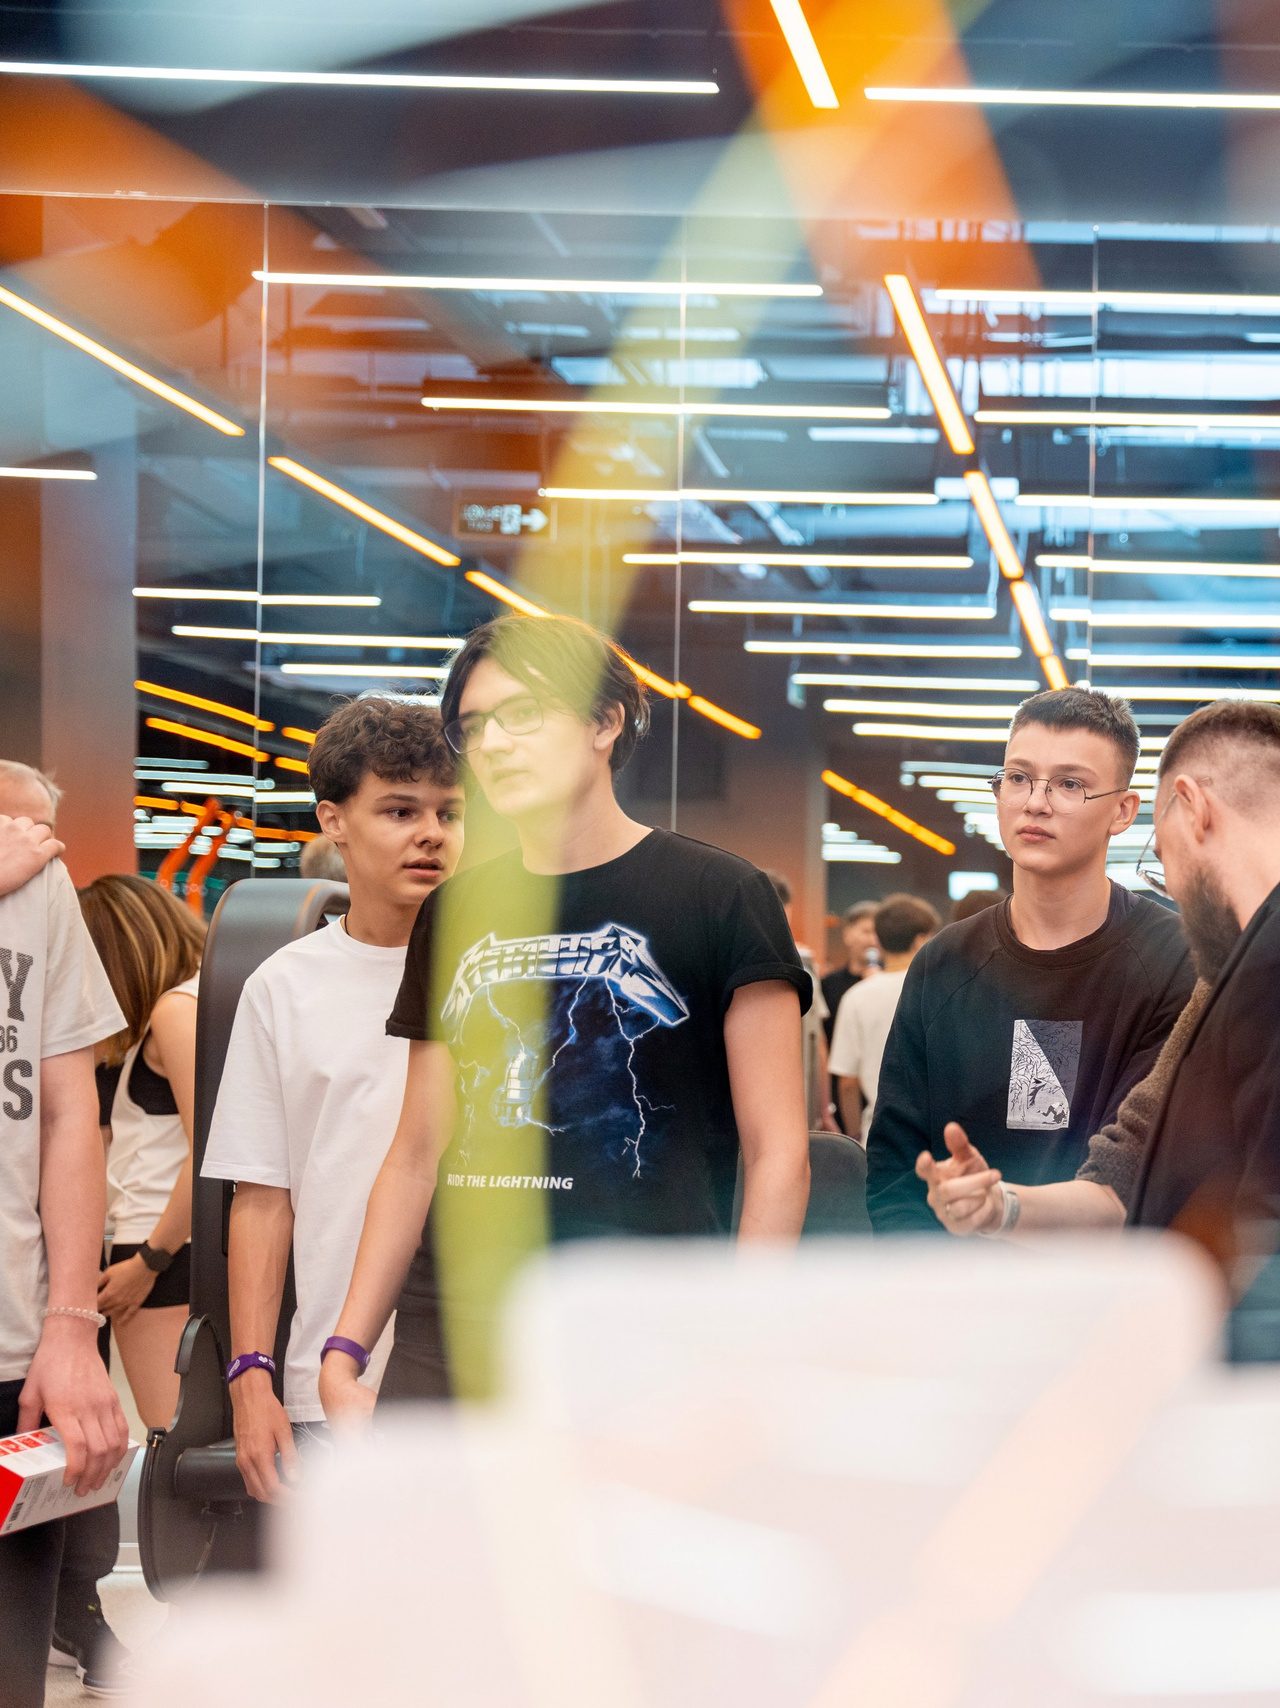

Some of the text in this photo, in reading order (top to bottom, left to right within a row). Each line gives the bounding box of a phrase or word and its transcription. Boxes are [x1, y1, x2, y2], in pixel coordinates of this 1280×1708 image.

[447, 1173, 574, 1190] RIDE THE LIGHTNING
